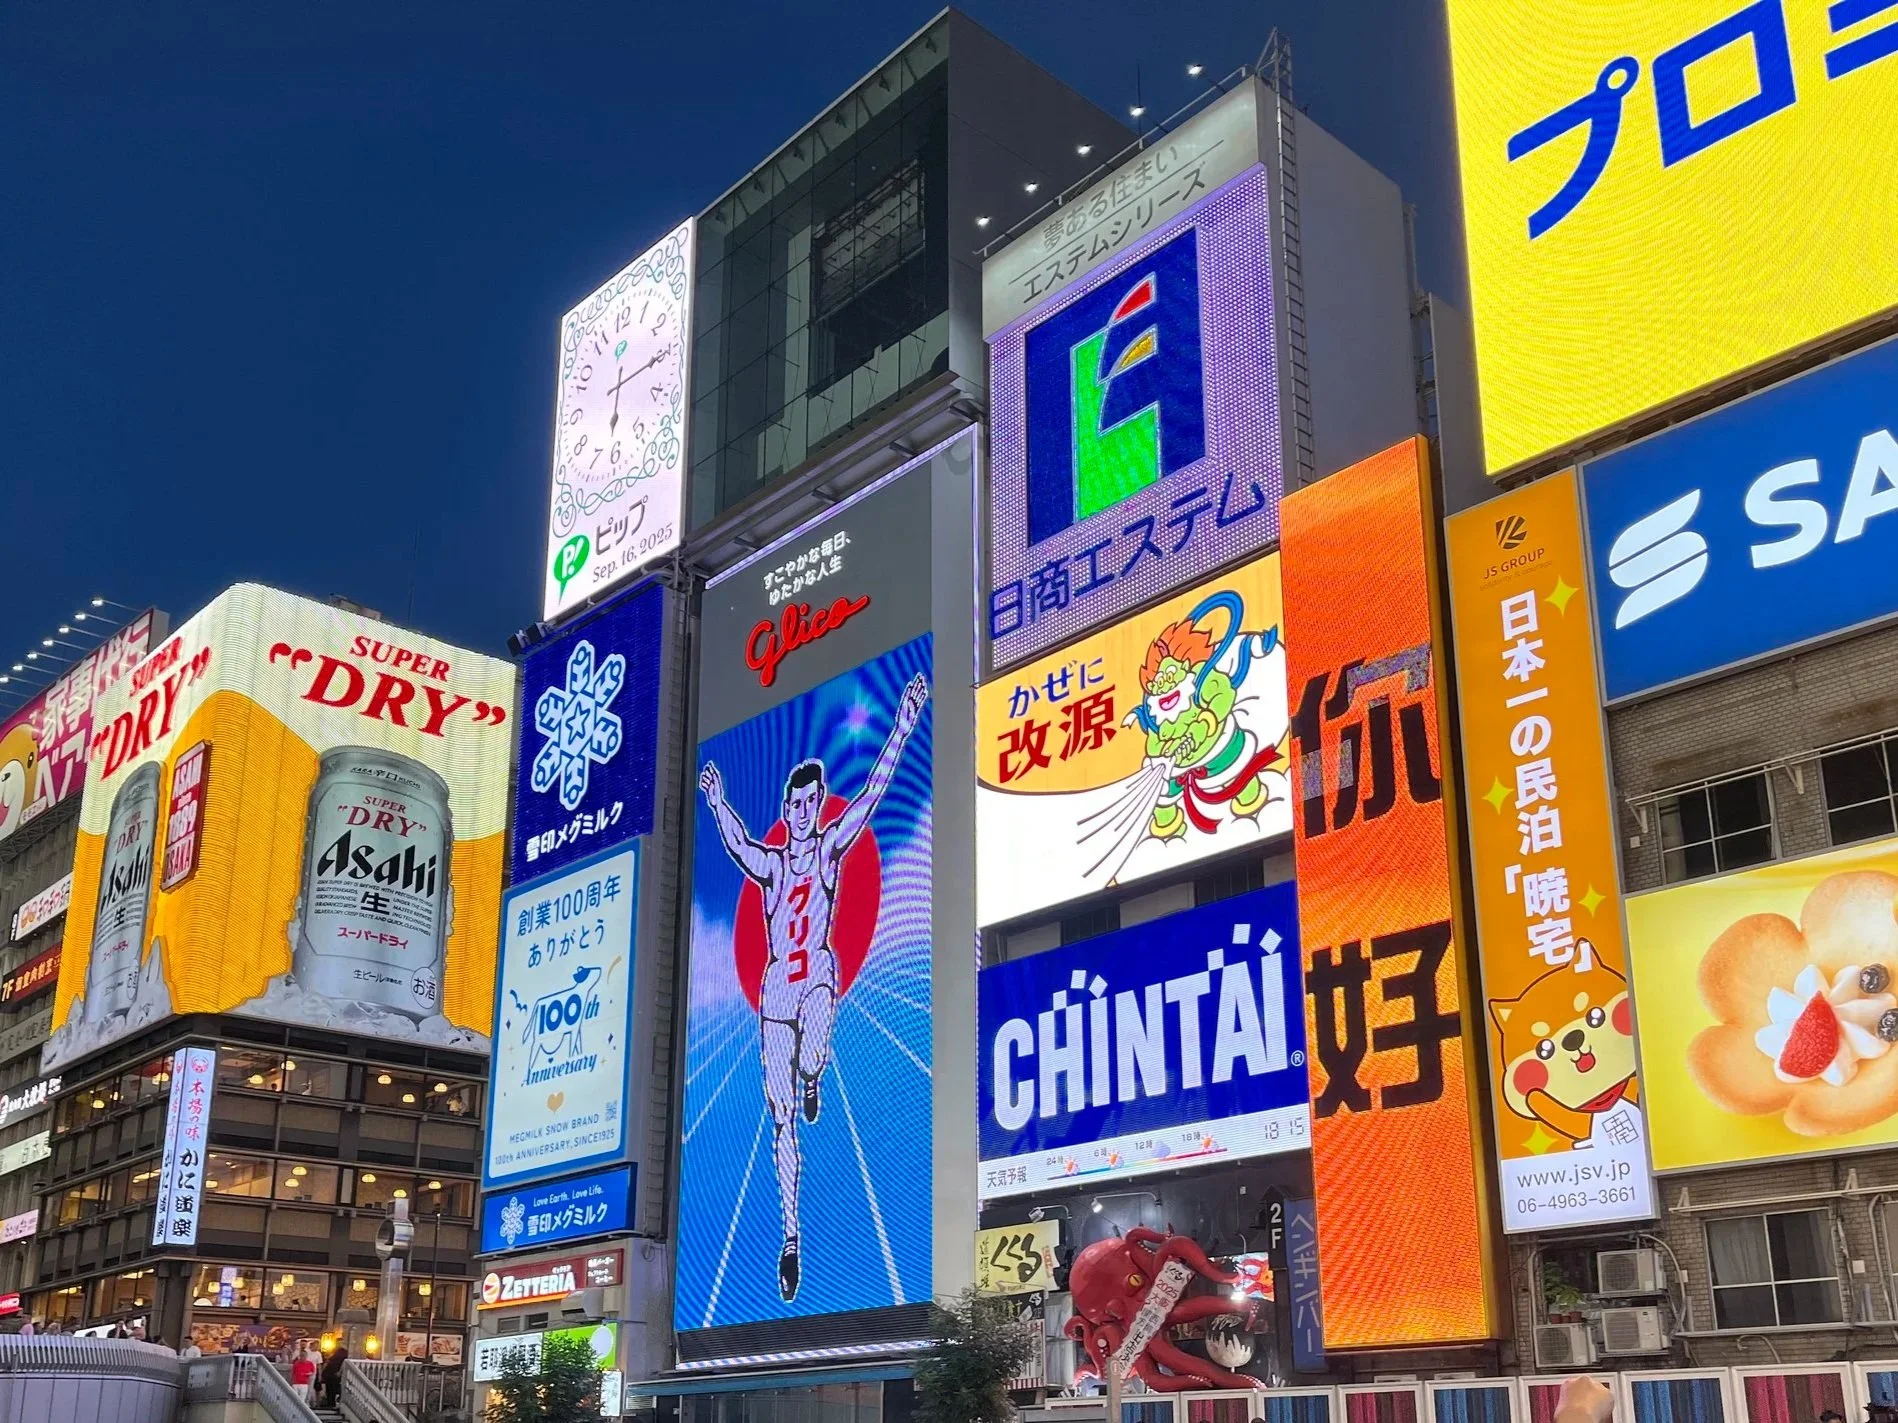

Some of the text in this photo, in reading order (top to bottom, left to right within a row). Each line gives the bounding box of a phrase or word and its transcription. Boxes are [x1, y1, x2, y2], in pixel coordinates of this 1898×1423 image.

[1043, 145, 1179, 250] 夢ある住まい
[1023, 160, 1207, 303] エステムシリーズ
[1745, 429, 1898, 568] SA
[595, 494, 649, 556] ピップ
[592, 560, 618, 583] Sep.
[640, 522, 673, 556] 2025
[763, 530, 851, 590] すこやかな毎日、
[990, 473, 1266, 640] 日商エステム
[1484, 548, 1545, 579] JS GROUP
[769, 554, 843, 606] ゆたかな人生
[130, 636, 182, 697] SUPER
[349, 635, 451, 682] SUPER
[1008, 657, 1105, 719] かぜに
[997, 684, 1117, 784] 改源
[363, 796, 407, 814] SUPER
[526, 800, 624, 862] 雪印メグミルク
[317, 829, 437, 899] Asahi
[361, 891, 390, 915] 生
[517, 874, 621, 937] 創業100周年
[337, 926, 409, 950] スーパードライ
[528, 918, 605, 968] ありがとう
[787, 875, 813, 984] グリコ
[538, 993, 600, 1035] 100th
[521, 1053, 598, 1088] Anniversary
[184, 1079, 206, 1142] 本場の味
[509, 1113, 600, 1144] MEGMILK SNOW BRAND
[495, 1154, 514, 1165] 100th
[987, 1165, 1027, 1188] 天気予報
[1517, 1159, 1631, 1188] www.jsv.jp
[171, 1147, 199, 1238] かに道楽
[533, 1186, 604, 1208] Love Earth. Love Life.
[1517, 1186, 1636, 1214] 06-4963-3661
[527, 1202, 608, 1237] 雪印メグミルク
[990, 1233, 1042, 1283] くくる
[500, 1272, 577, 1300] ZETTERIA
[1156, 1280, 1180, 1299] 2025
